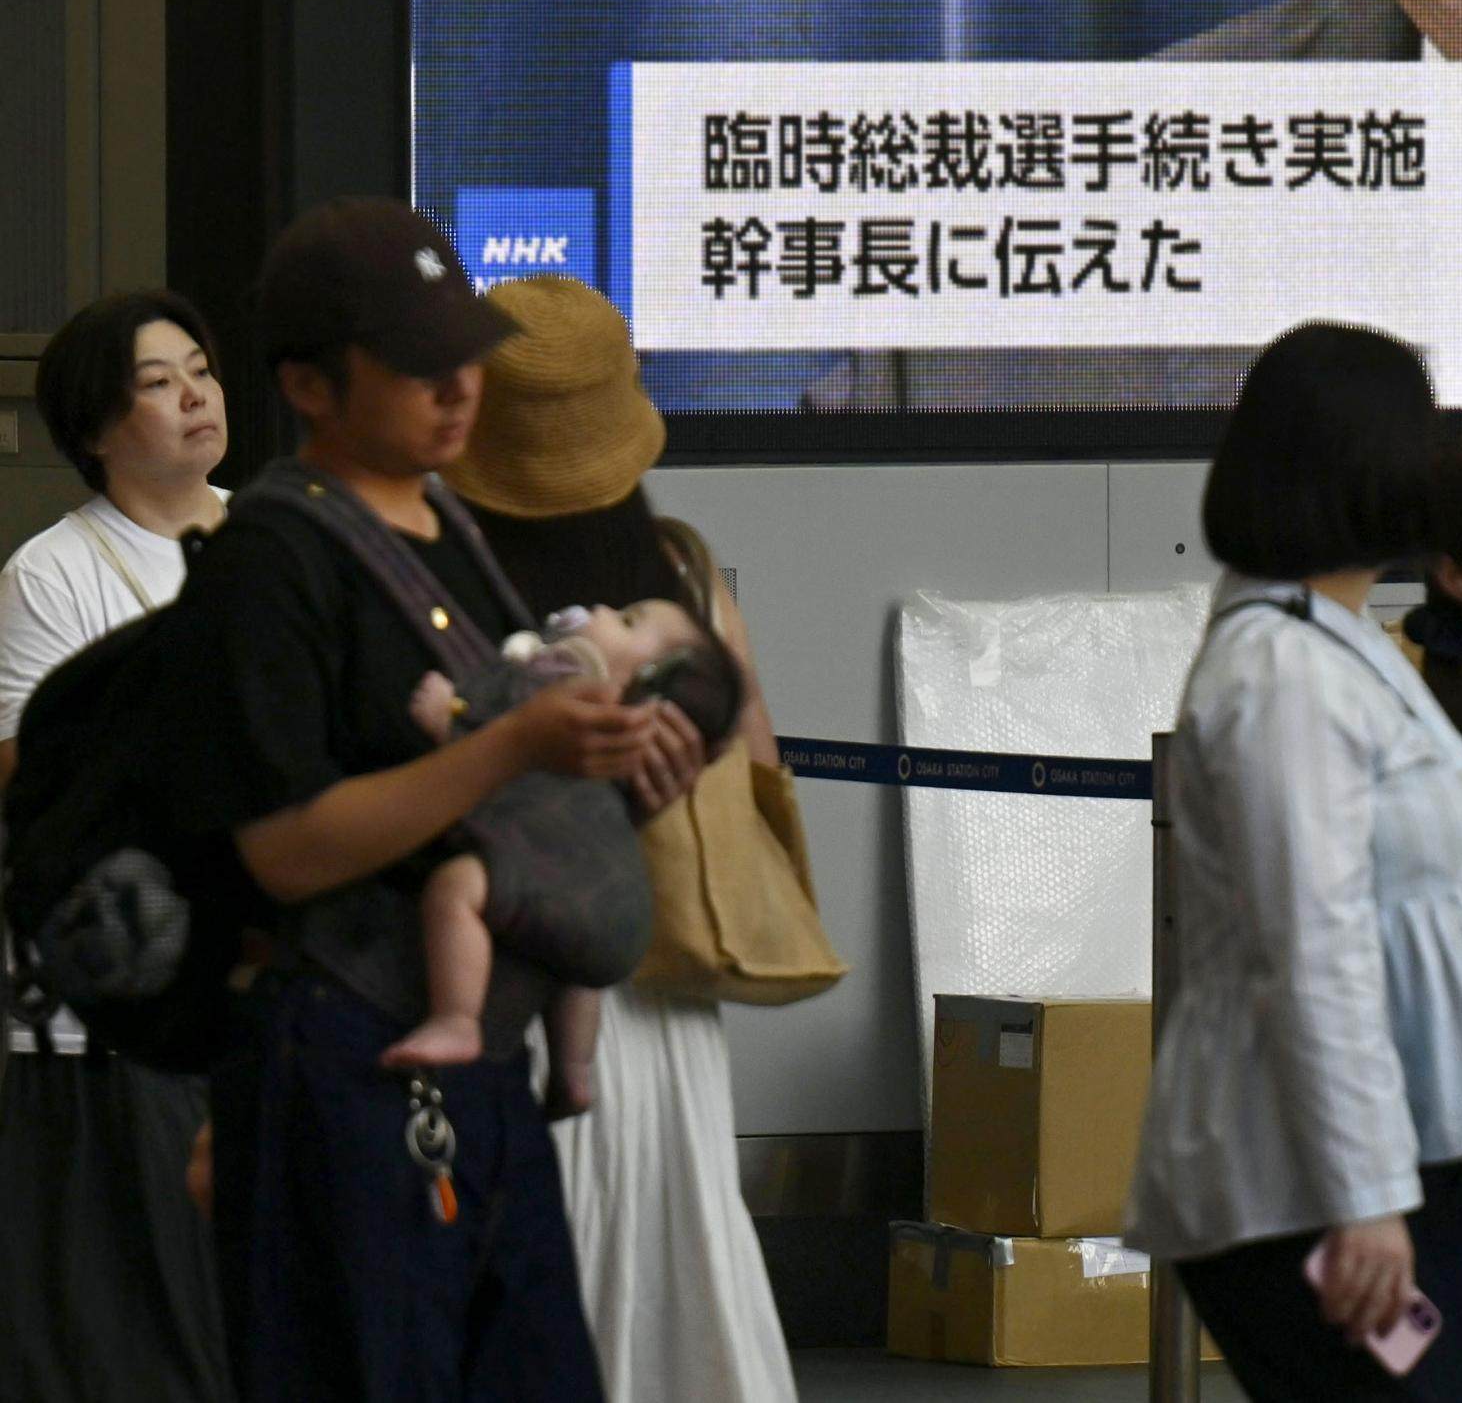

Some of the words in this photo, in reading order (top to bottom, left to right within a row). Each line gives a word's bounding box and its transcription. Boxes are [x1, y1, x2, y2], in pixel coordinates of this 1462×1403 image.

[704, 110, 1426, 193] 臨時総裁選手続き実施
[482, 235, 570, 266] NHK
[701, 213, 1202, 300] 幹事長に伝えた
[784, 750, 810, 766] OSAKA
[814, 753, 847, 769] STATION
[849, 756, 866, 771] CITY
[916, 760, 943, 776] OSAKA
[946, 762, 979, 778] STATION
[982, 764, 1000, 780] CITY
[1051, 767, 1078, 783] OSAKA
[1081, 769, 1115, 785] STATION
[1118, 772, 1136, 786] CITY
